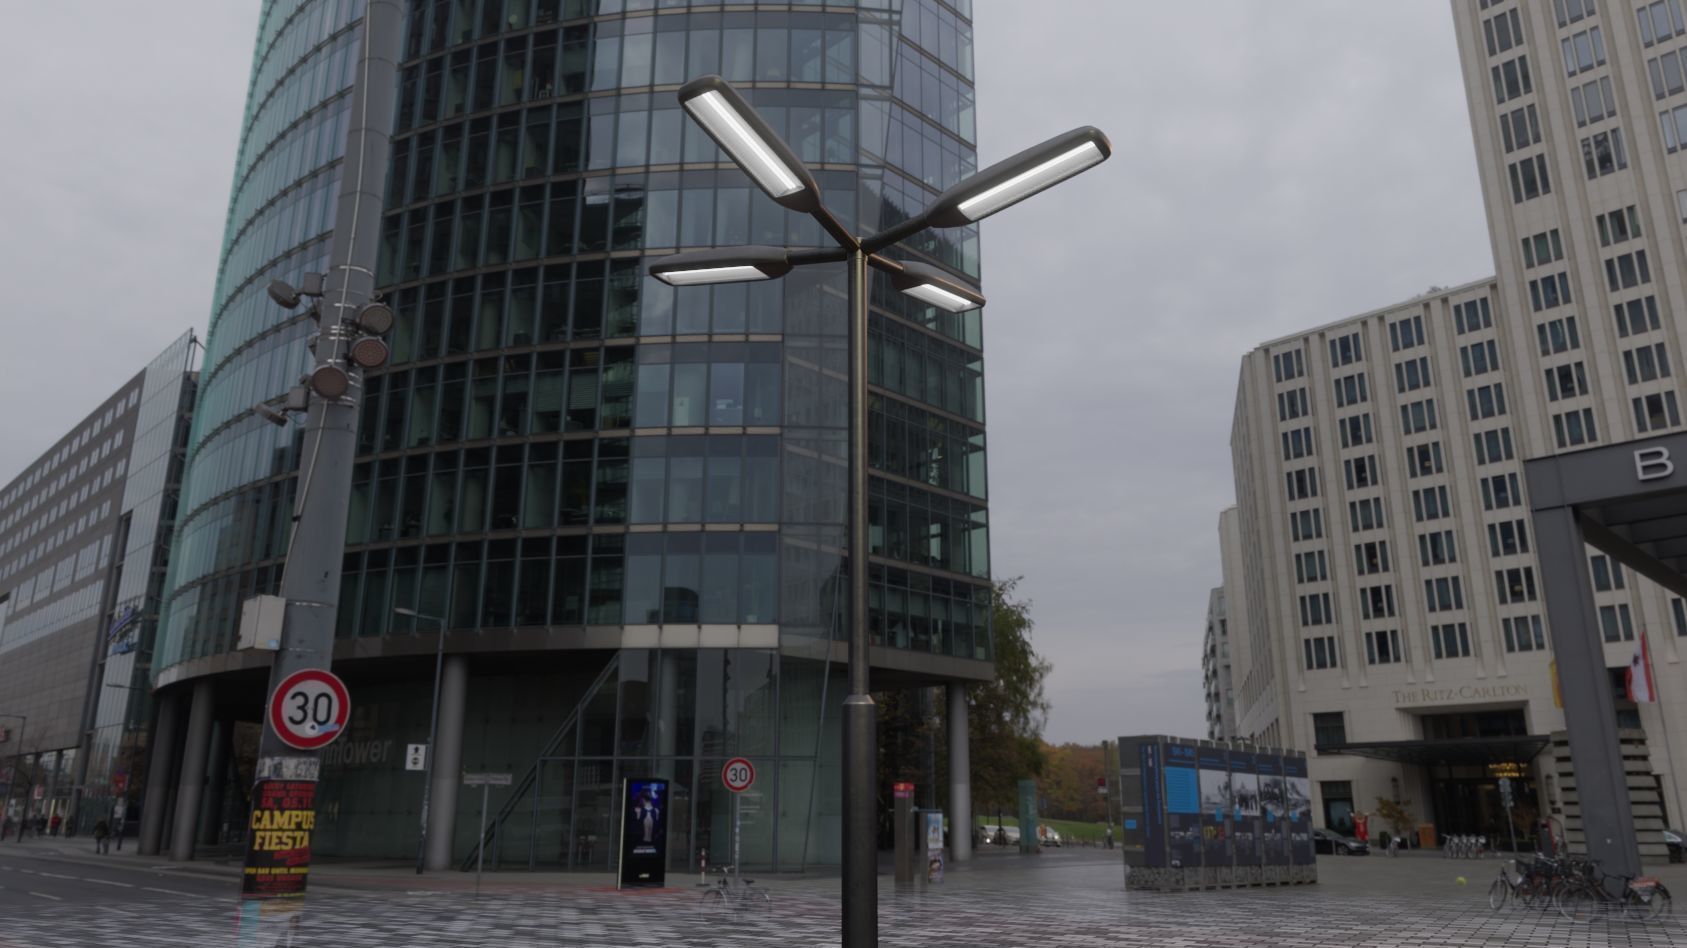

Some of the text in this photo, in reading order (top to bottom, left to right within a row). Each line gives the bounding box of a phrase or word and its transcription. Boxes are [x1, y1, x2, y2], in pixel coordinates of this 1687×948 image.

[1634, 446, 1674, 481] B
[1392, 689, 1417, 704] THE
[288, 691, 333, 725] 30
[729, 767, 748, 782] 30
[251, 810, 315, 830] CAMPUS
[253, 830, 310, 850] FIESTA
